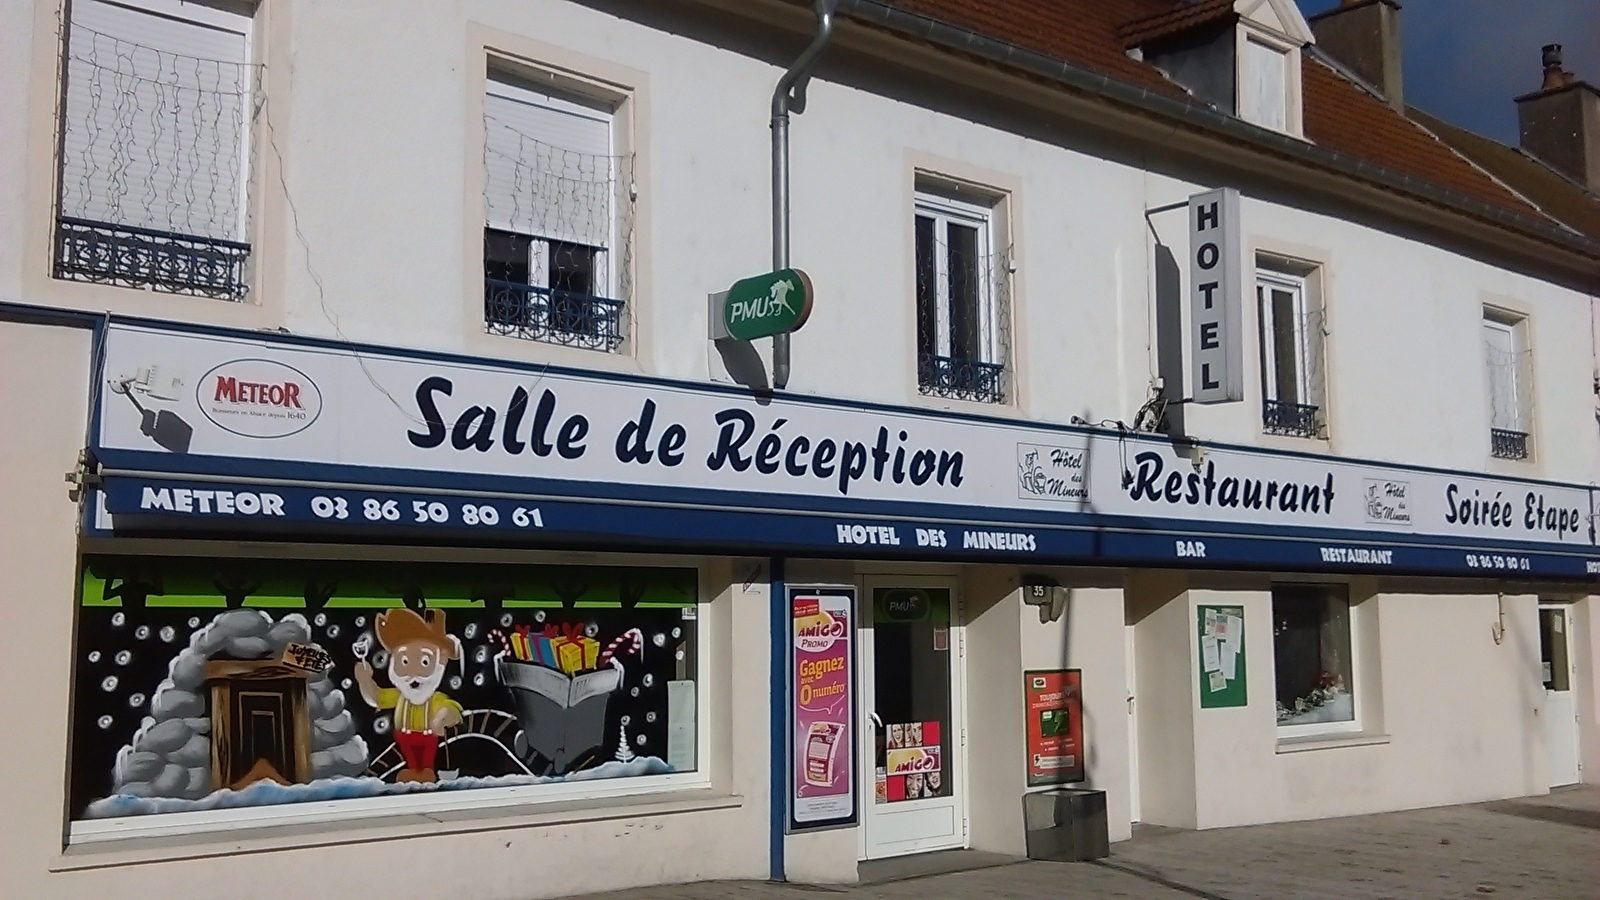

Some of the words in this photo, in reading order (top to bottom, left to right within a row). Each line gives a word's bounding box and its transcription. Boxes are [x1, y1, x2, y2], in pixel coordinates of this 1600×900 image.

[1197, 202, 1219, 390] HOTEL
[731, 296, 769, 324] PMU
[214, 375, 303, 408] METEOR
[287, 411, 306, 420] 1640
[407, 376, 589, 460] Salle
[615, 398, 687, 467] de
[706, 408, 964, 496] Réception
[1050, 448, 1083, 469] Hôtel
[1047, 477, 1089, 498] Mineurs
[1071, 473, 1083, 483] des
[1130, 451, 1335, 515] Restaurant
[140, 486, 286, 516] METEOR
[310, 495, 350, 520] 03
[362, 498, 401, 521] 86
[412, 500, 450, 523] 50
[461, 503, 500, 526] 80
[511, 506, 544, 528] 61
[1445, 483, 1512, 528] Soirée
[1524, 491, 1580, 541] Etape
[836, 524, 901, 545] HOTEL
[915, 528, 948, 548] DES
[963, 530, 1036, 552] MINEURS
[1175, 540, 1206, 557] BAR
[1320, 547, 1393, 565] RESTAURANT
[1466, 554, 1479, 568] 03
[1492, 555, 1505, 569] 50
[1520, 557, 1531, 571] 61
[1033, 585, 1044, 597] 35
[889, 601, 910, 612] PMU
[800, 656, 845, 680] Gagnez
[812, 680, 845, 698] numéro
